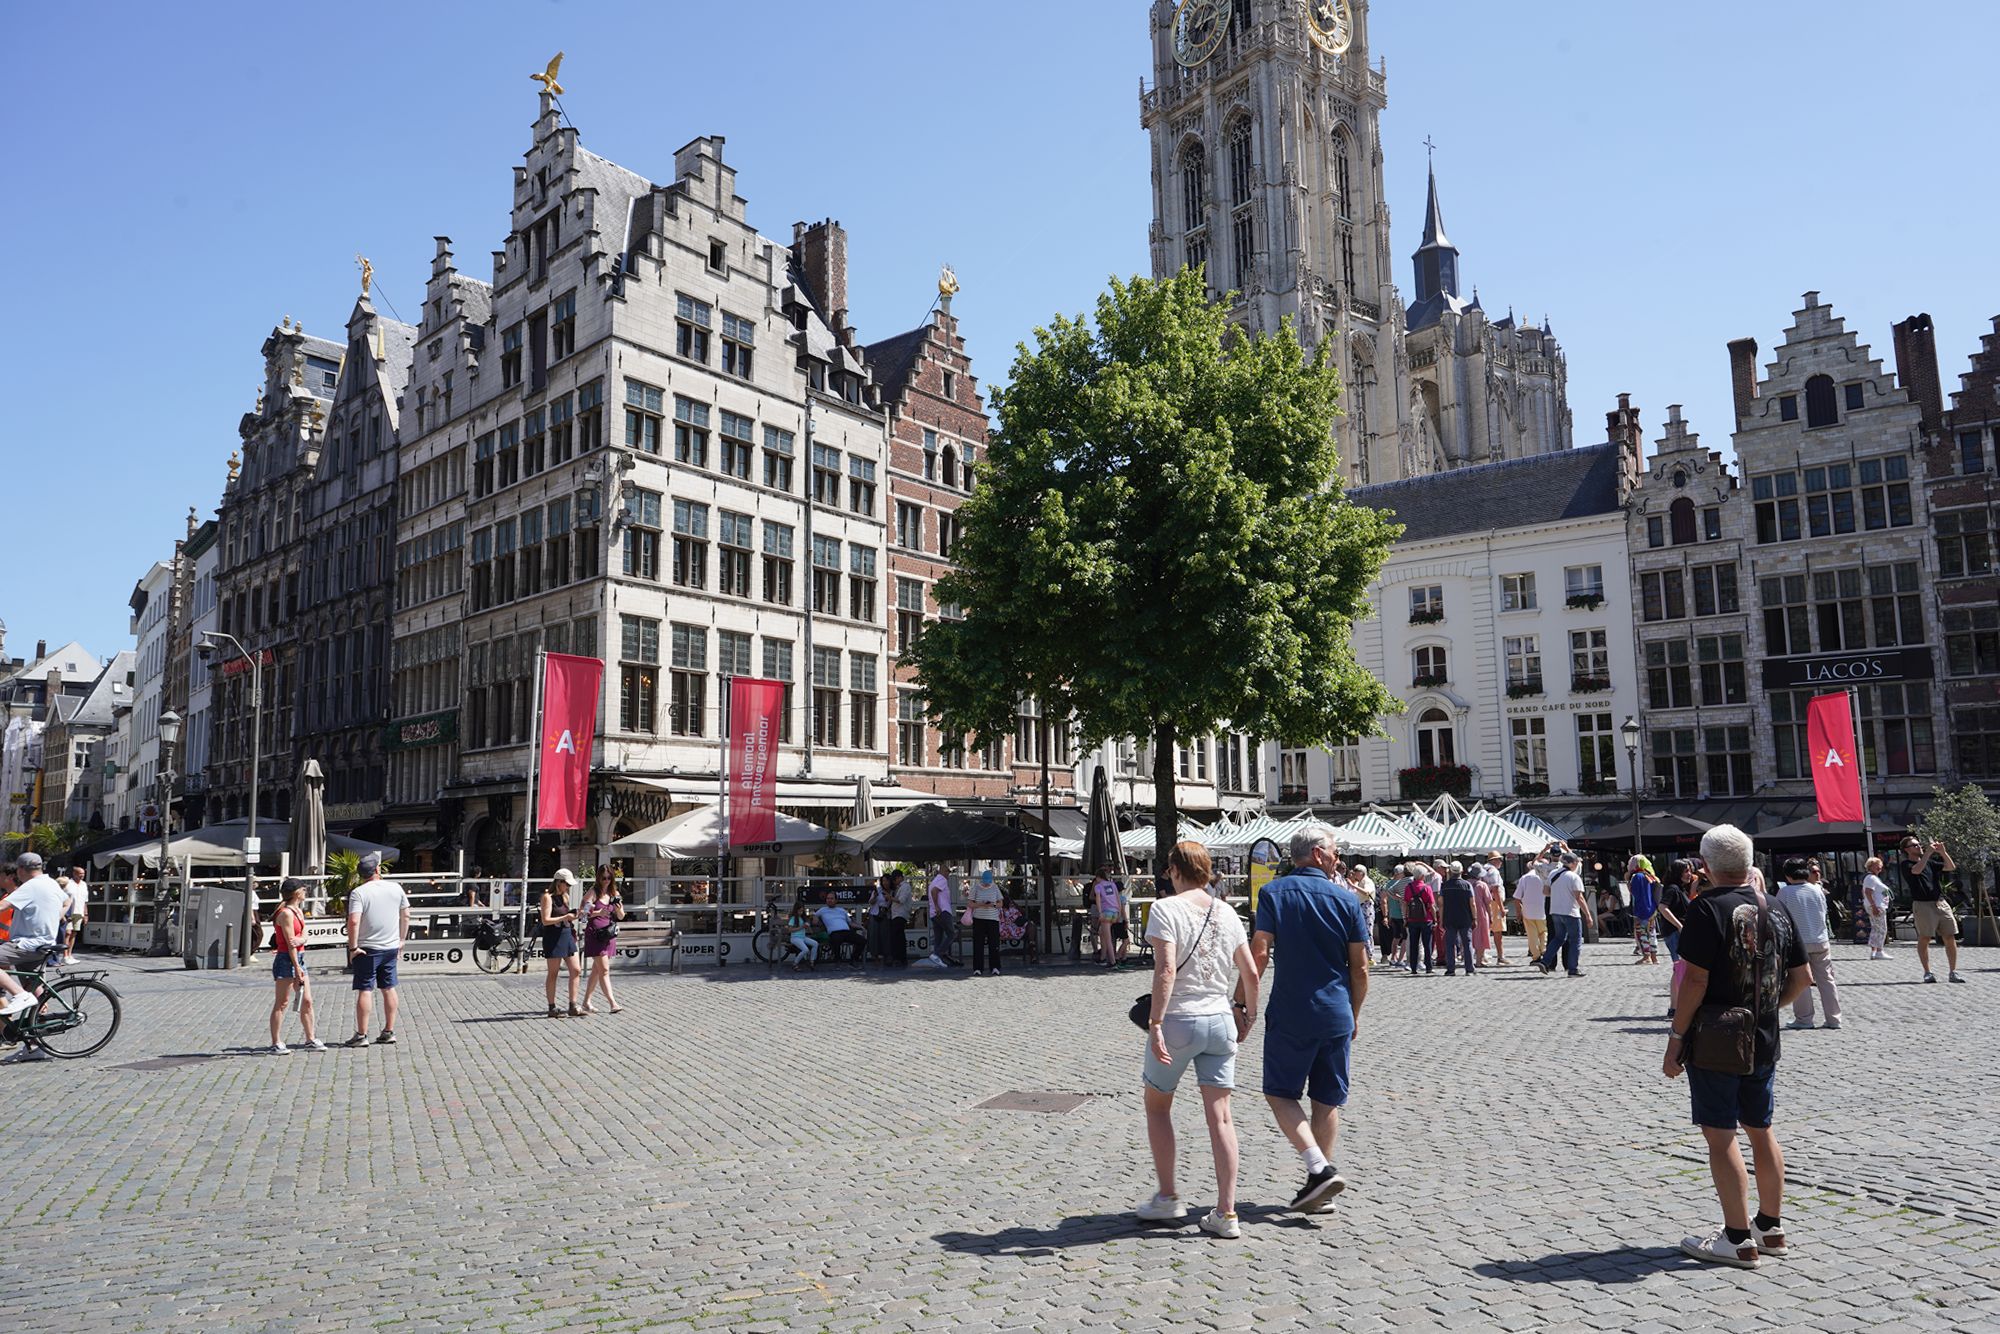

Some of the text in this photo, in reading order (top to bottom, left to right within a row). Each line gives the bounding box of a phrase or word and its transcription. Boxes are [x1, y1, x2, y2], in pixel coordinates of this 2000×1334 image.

[1805, 657, 1884, 681] LACO'S
[1506, 705, 1539, 714] GRAND
[1569, 702, 1582, 710] DU
[1585, 700, 1611, 709] NORD
[555, 729, 576, 755] A
[741, 732, 756, 791] Allemaal
[751, 714, 769, 807] Antwerpenaar
[1824, 748, 1844, 768] A
[307, 928, 339, 937] SUPER
[402, 952, 445, 962] SUPER
[681, 945, 715, 954] SUPER
